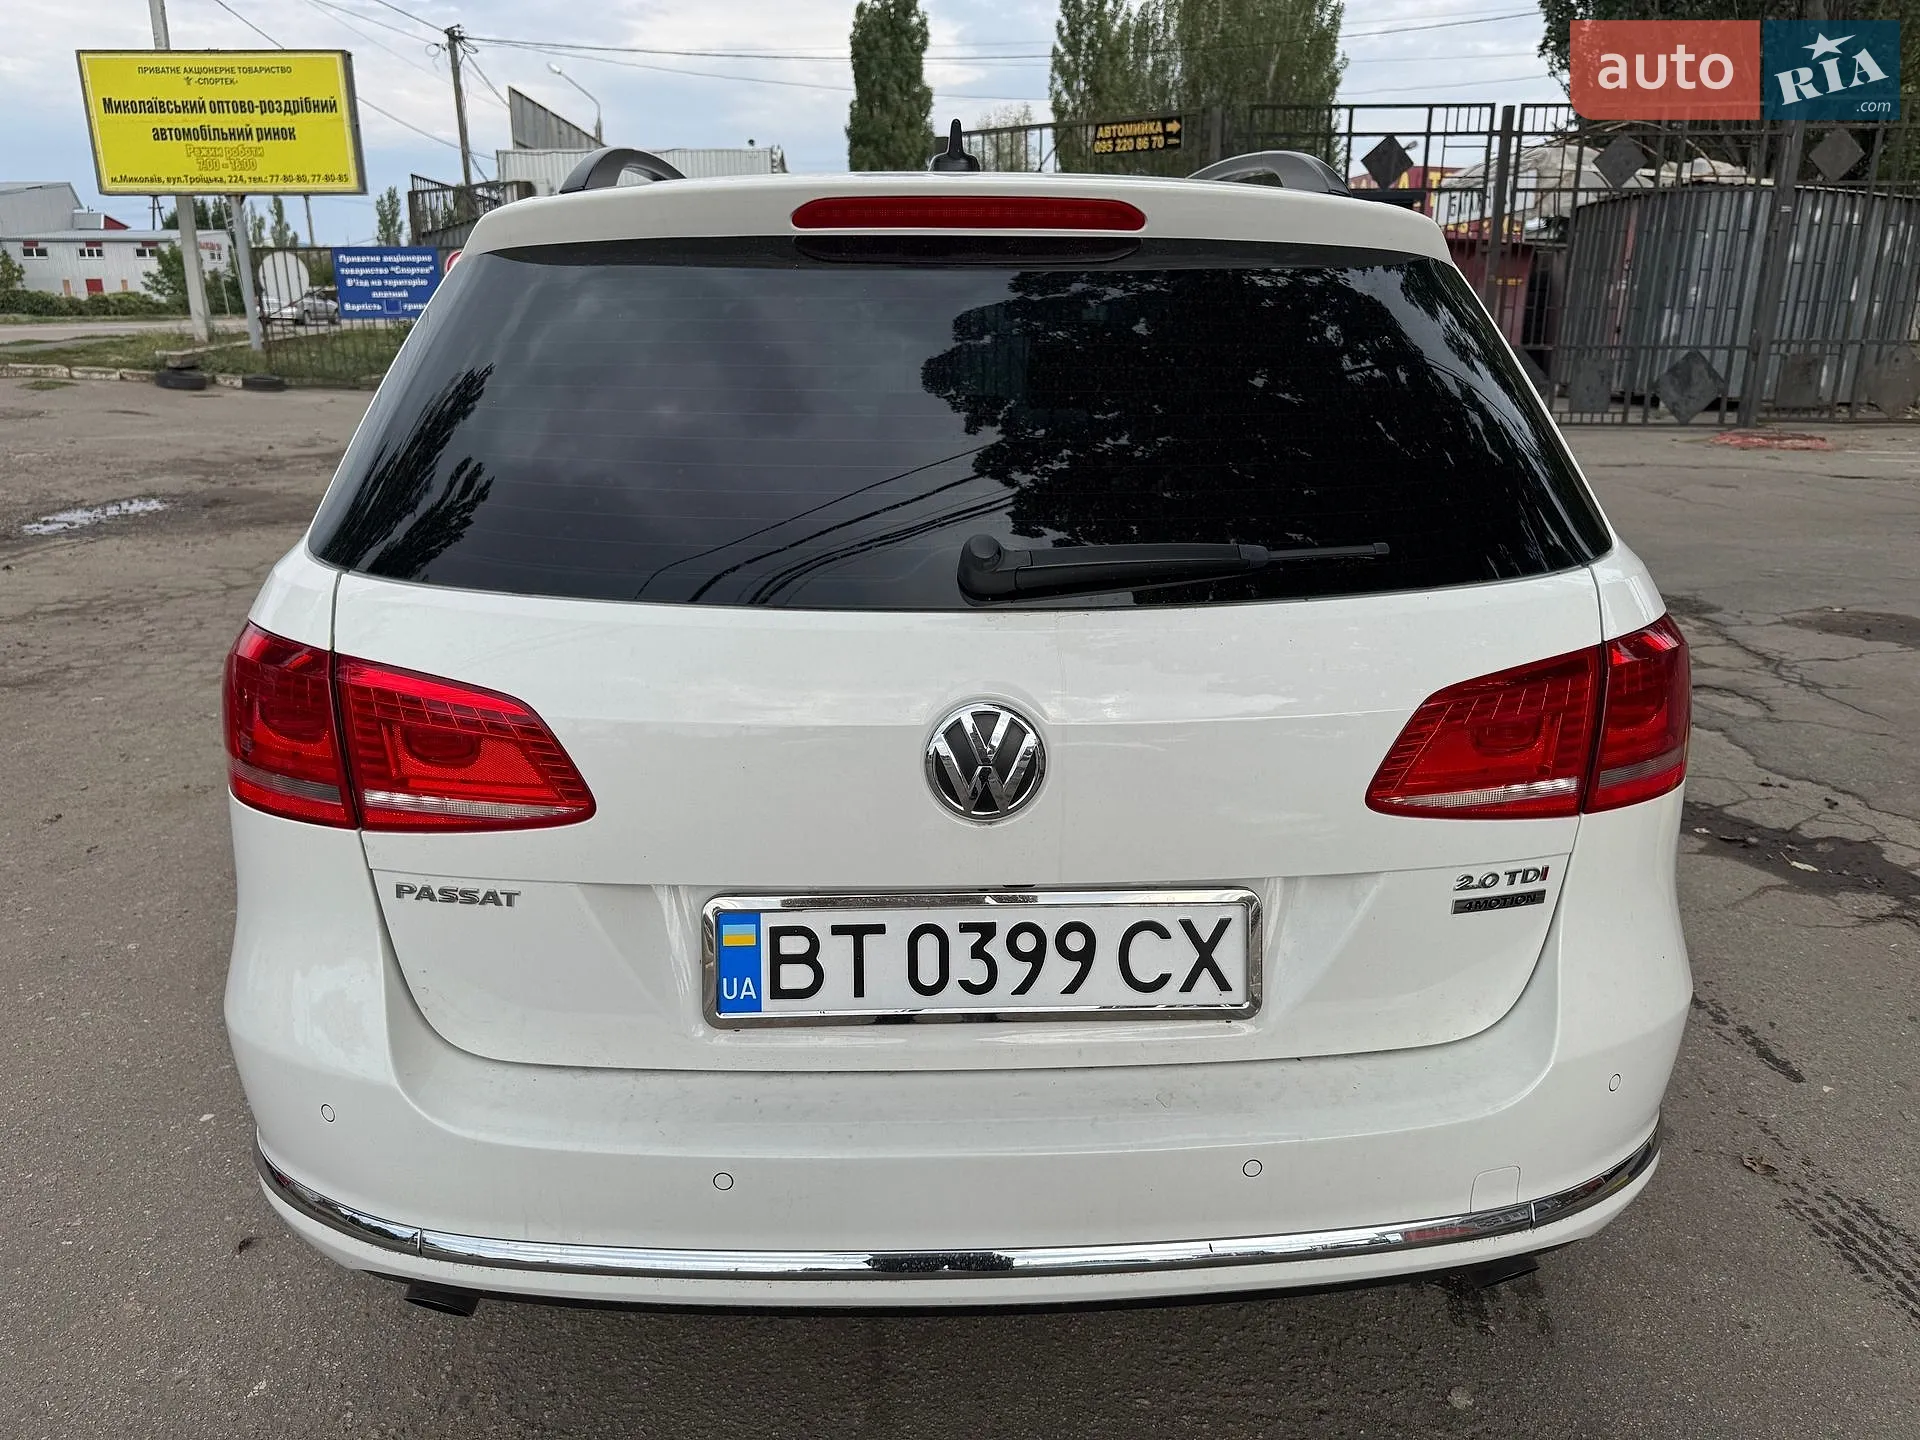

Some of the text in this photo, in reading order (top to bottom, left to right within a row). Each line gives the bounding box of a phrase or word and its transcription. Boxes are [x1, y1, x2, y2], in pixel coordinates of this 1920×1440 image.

[137, 66, 181, 75] ПРИВАТНЕ
[237, 66, 292, 75] ТОВАРИСТВО
[102, 96, 338, 116] Миколаївський оптово-роздрібний
[151, 124, 297, 142] автомобільний ринок
[1096, 121, 1163, 139] АВТОМИЙКА
[1151, 134, 1165, 149] 70
[185, 144, 223, 158] Режим
[1453, 865, 1549, 891] 2.0 TDI
[395, 882, 522, 907] PASSAT
[1464, 893, 1537, 910] 4MOTION
[768, 918, 1233, 1000] BT 0399 CX
[723, 977, 757, 999] UA
